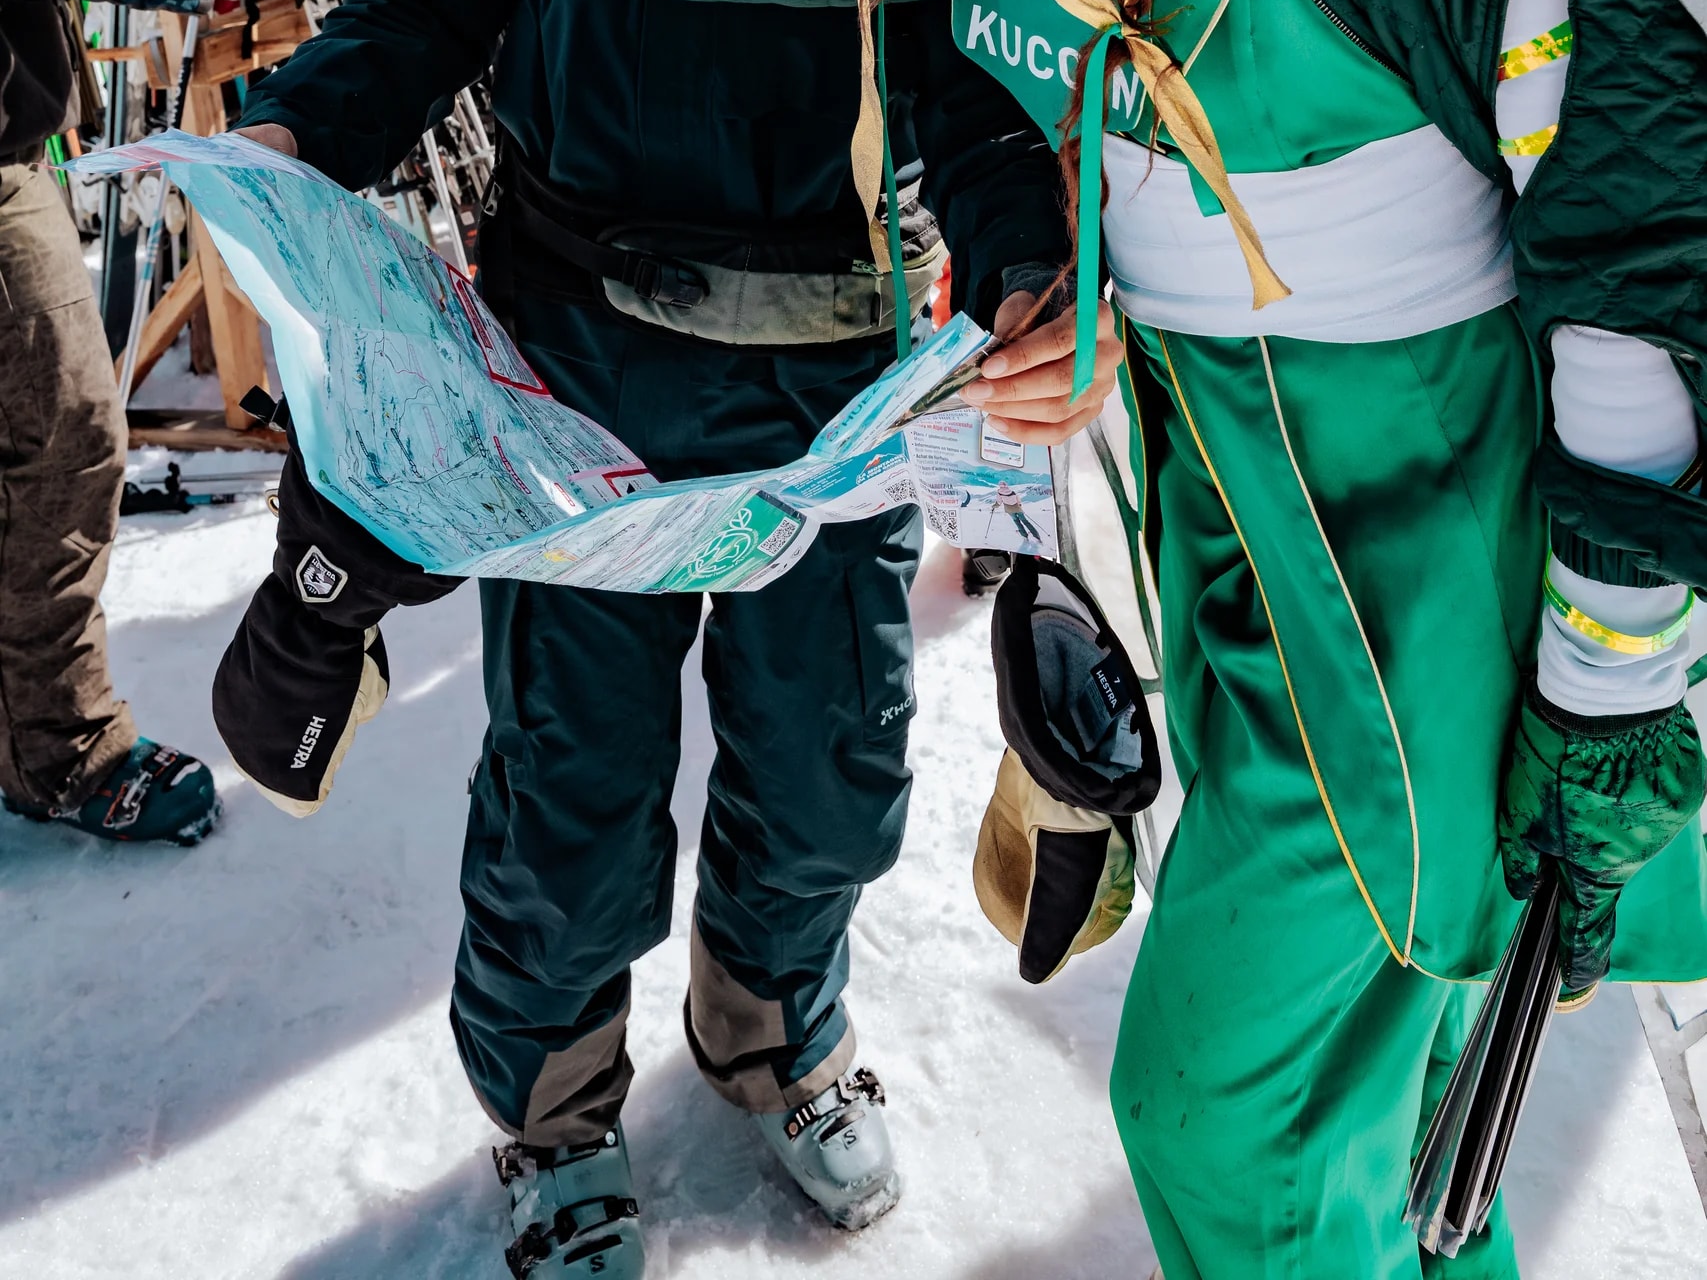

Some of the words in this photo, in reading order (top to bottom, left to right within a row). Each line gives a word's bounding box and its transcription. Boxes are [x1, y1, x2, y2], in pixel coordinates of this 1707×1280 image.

[966, 4, 1140, 120] KUCON
[1096, 669, 1118, 709] HESTRA
[290, 715, 327, 769] HESTRA
